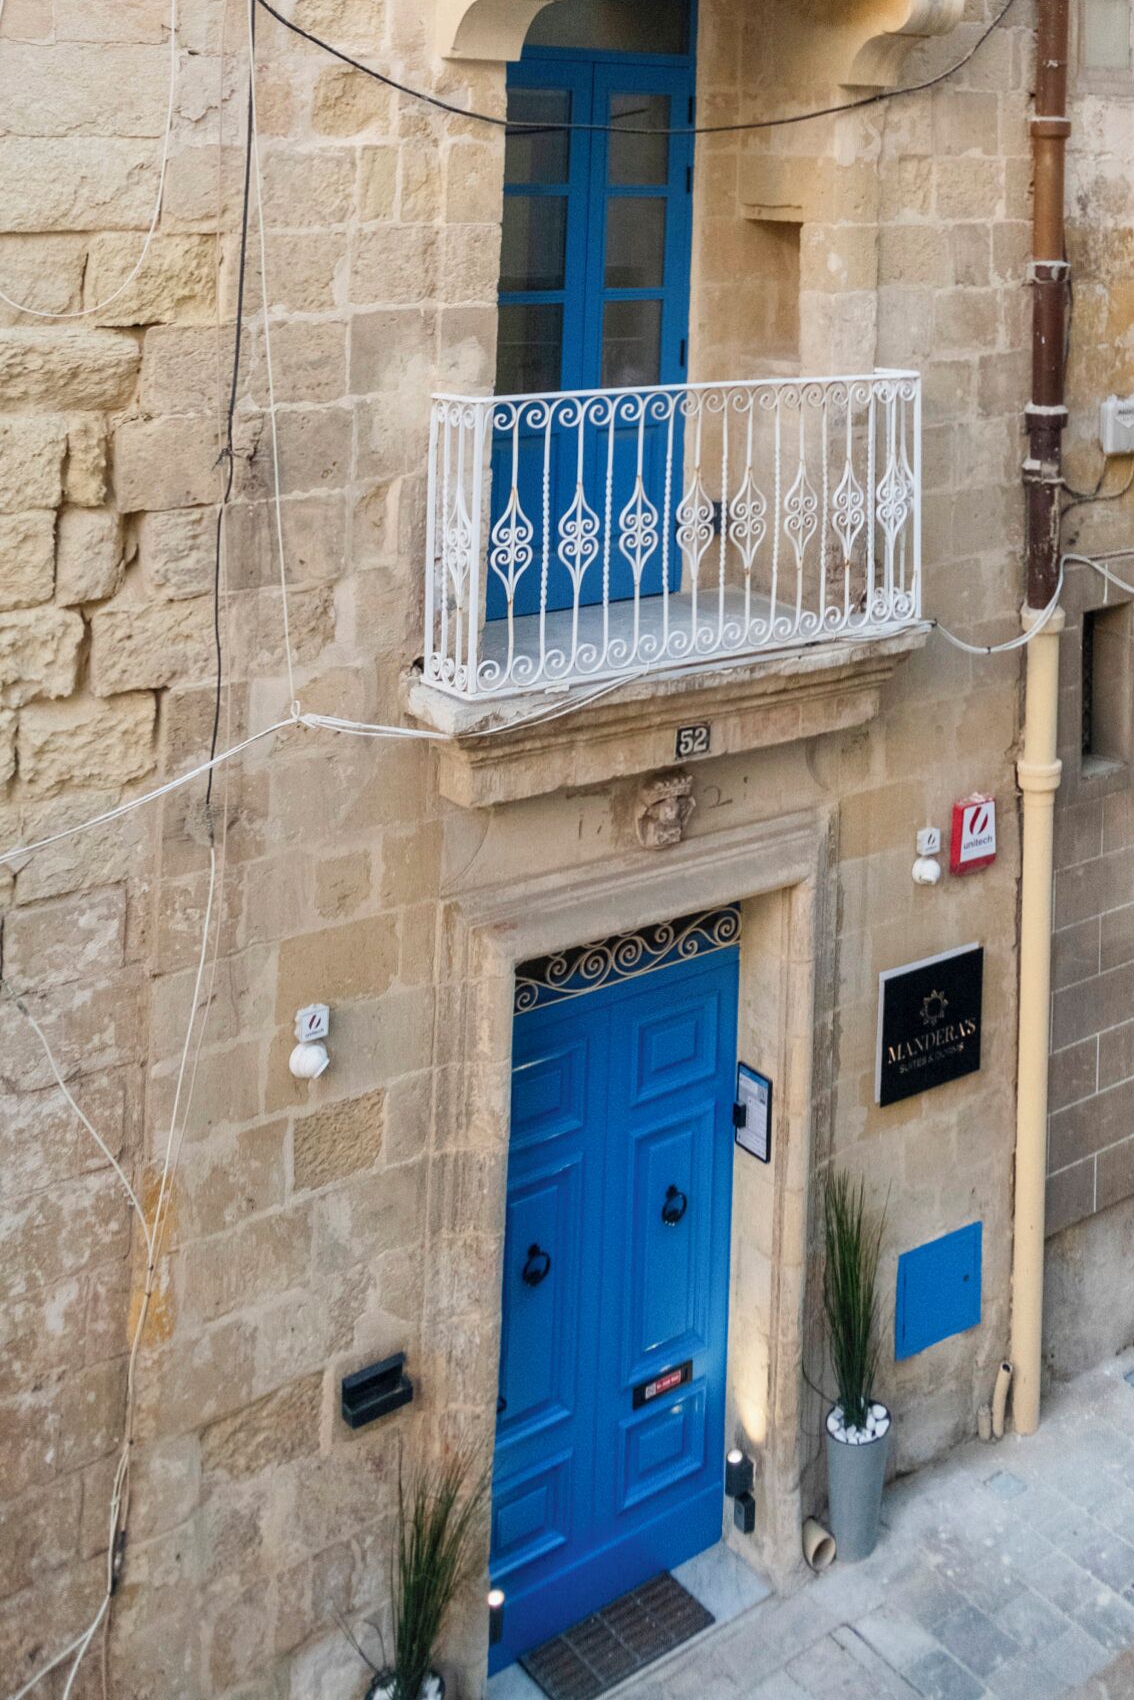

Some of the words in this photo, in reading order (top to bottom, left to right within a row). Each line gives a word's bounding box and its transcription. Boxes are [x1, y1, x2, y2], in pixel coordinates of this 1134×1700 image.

[679, 727, 707, 754] 52
[963, 835, 993, 850] unitech
[887, 1017, 977, 1064] MANDERA'S
